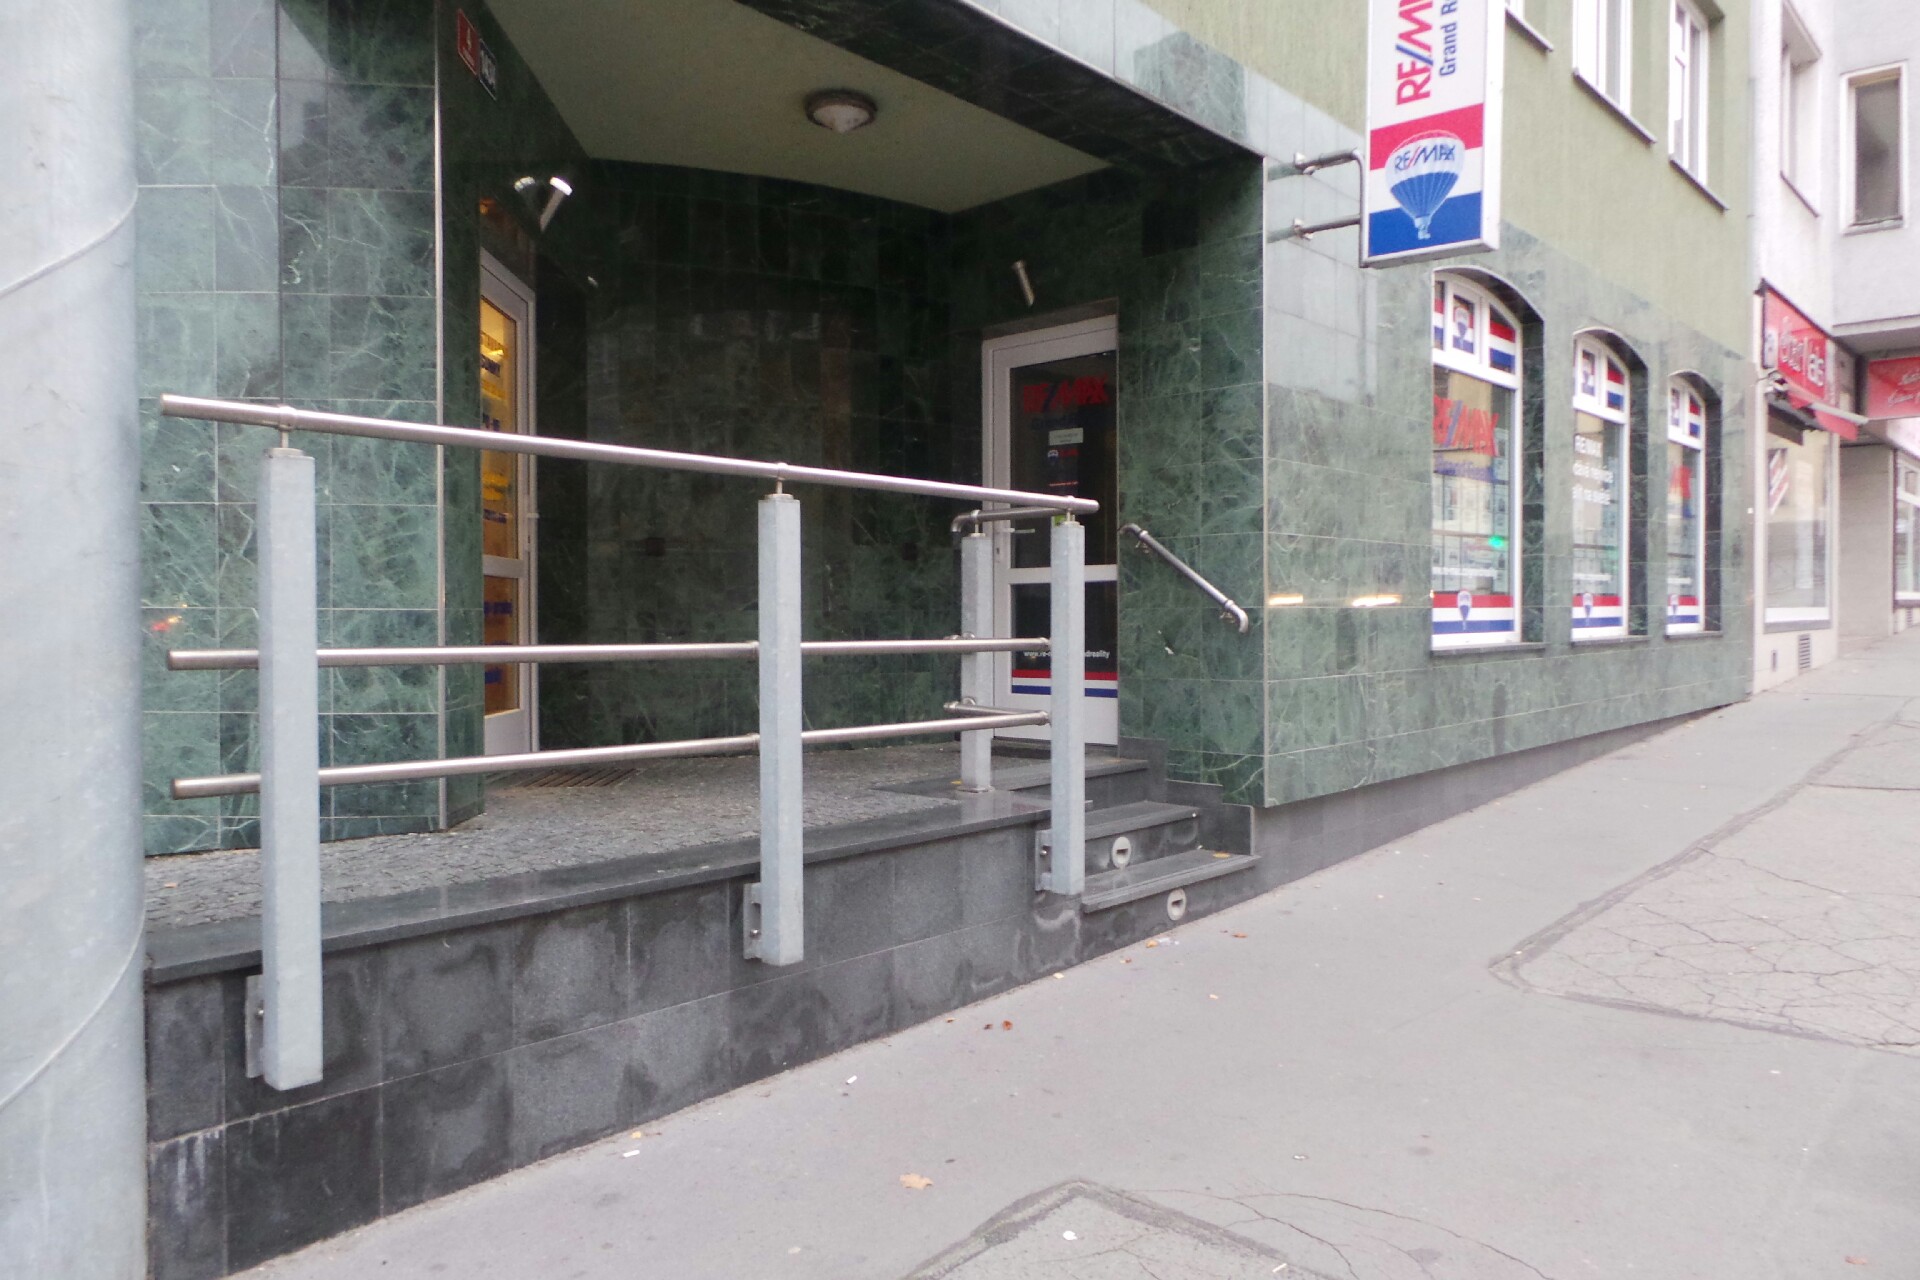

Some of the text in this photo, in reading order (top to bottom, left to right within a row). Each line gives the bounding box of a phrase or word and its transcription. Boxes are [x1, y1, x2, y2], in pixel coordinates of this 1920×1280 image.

[1439, 22, 1457, 76] Grand
[1394, 144, 1456, 171] RE/MAX
[1023, 372, 1109, 413] RE/MAX
